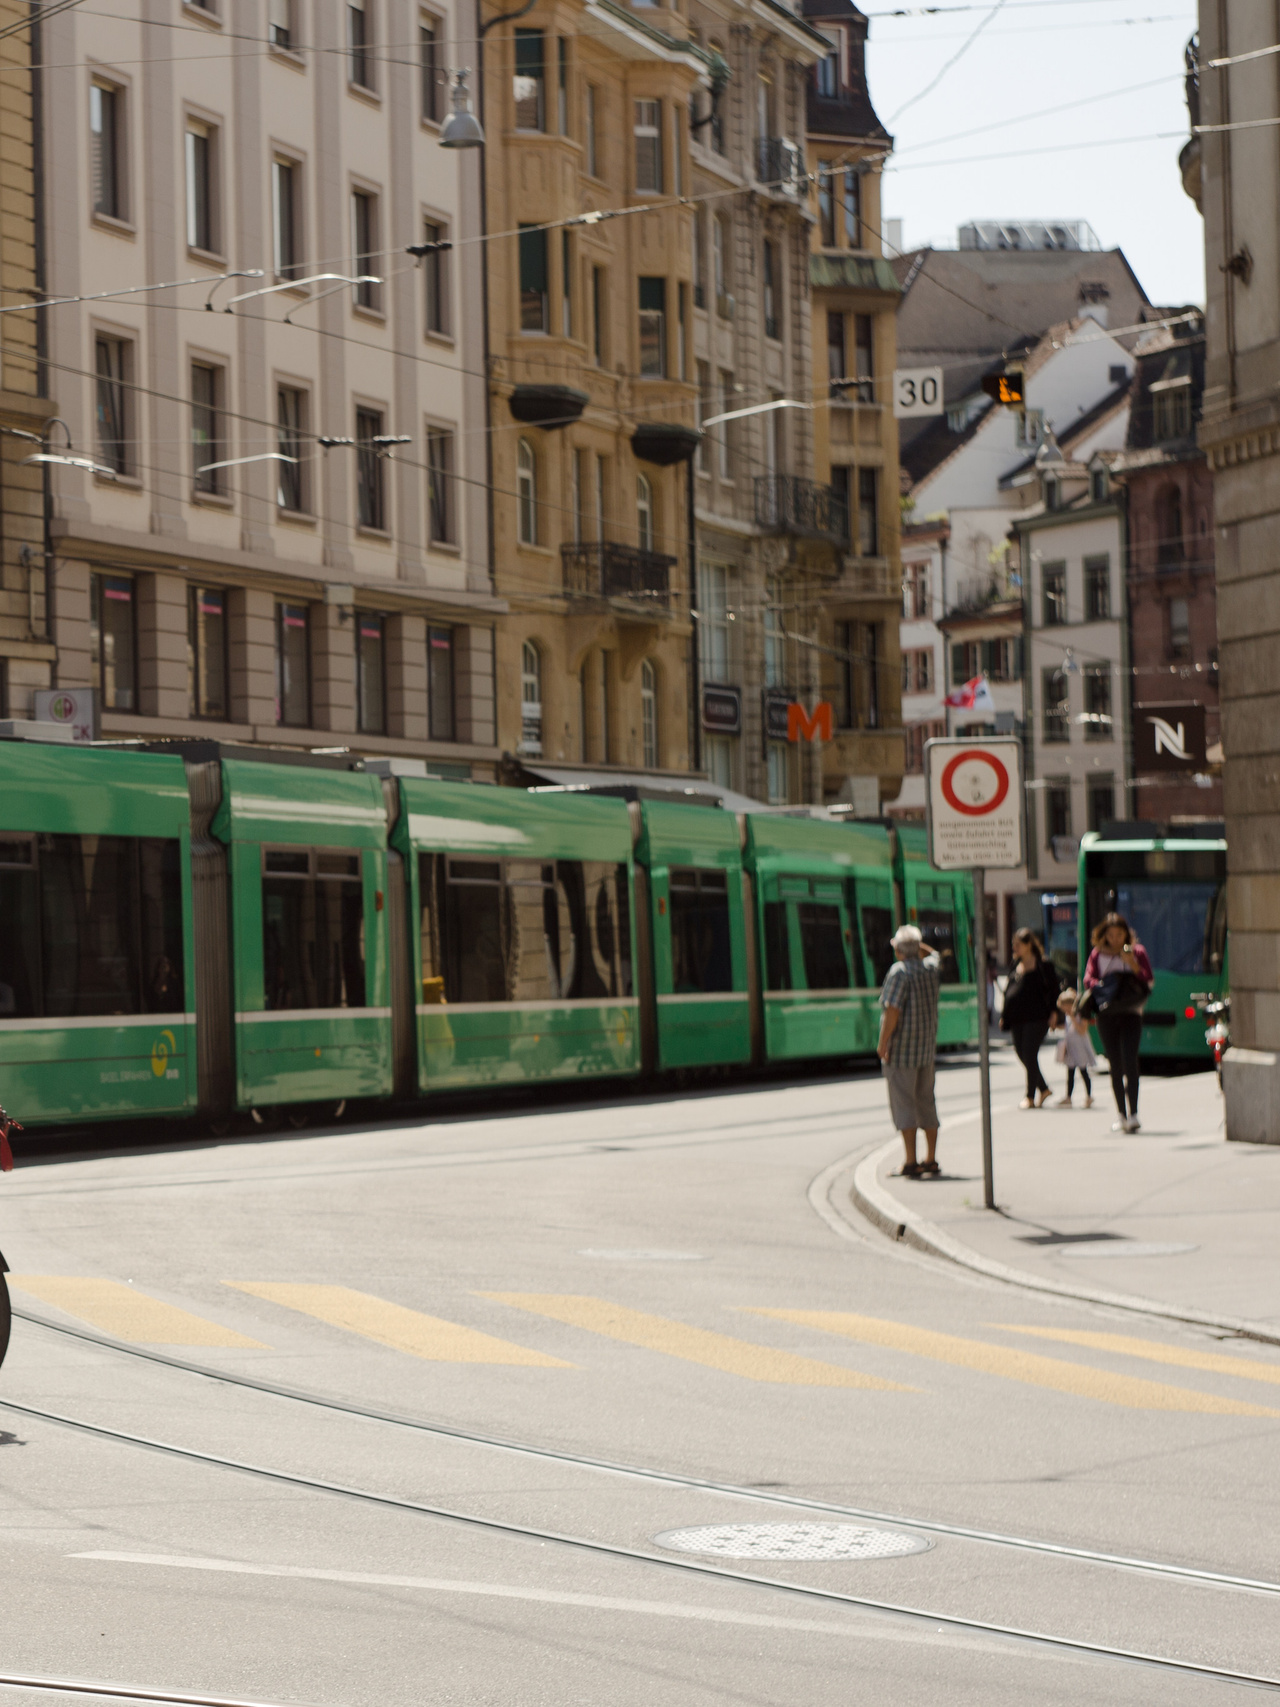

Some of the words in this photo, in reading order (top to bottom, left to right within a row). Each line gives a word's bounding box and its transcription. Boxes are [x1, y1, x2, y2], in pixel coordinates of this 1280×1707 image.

[900, 377, 937, 407] 30
[787, 702, 832, 741] M
[1144, 716, 1196, 760] N
